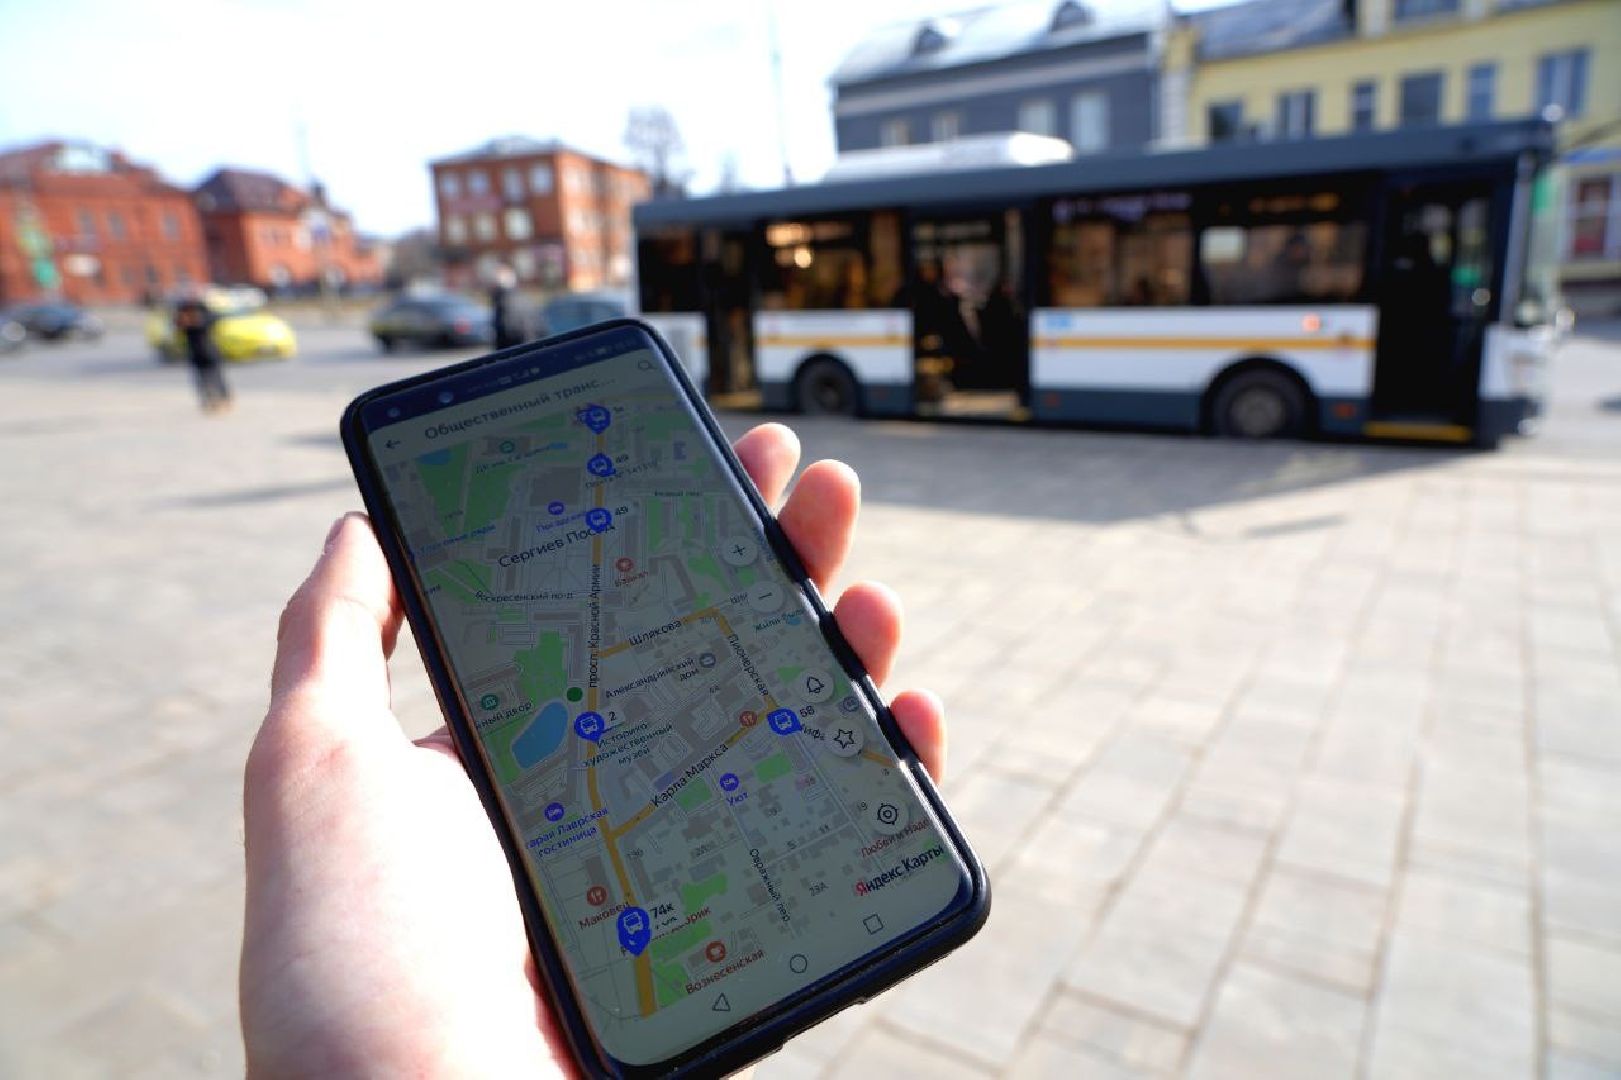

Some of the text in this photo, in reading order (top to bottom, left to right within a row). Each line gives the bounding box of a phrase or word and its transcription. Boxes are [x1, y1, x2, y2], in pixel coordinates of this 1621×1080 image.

[425, 394, 550, 439] Общественный
[498, 539, 564, 568] Сергиев
[591, 564, 602, 599] Армии
[587, 601, 600, 649] Красной
[628, 620, 682, 646] Шлякова
[679, 667, 699, 682] дом
[729, 634, 768, 697] Пионерская
[608, 711, 616, 722] 2
[582, 723, 673, 767] художественный
[618, 744, 650, 764] музей
[651, 743, 729, 808] Карла Маркса
[727, 791, 748, 806] Уют
[557, 808, 608, 836] Лаврская
[538, 827, 597, 858] гостиница
[855, 844, 944, 896] Яндекс Карты
[686, 949, 765, 994] Вознесенская
